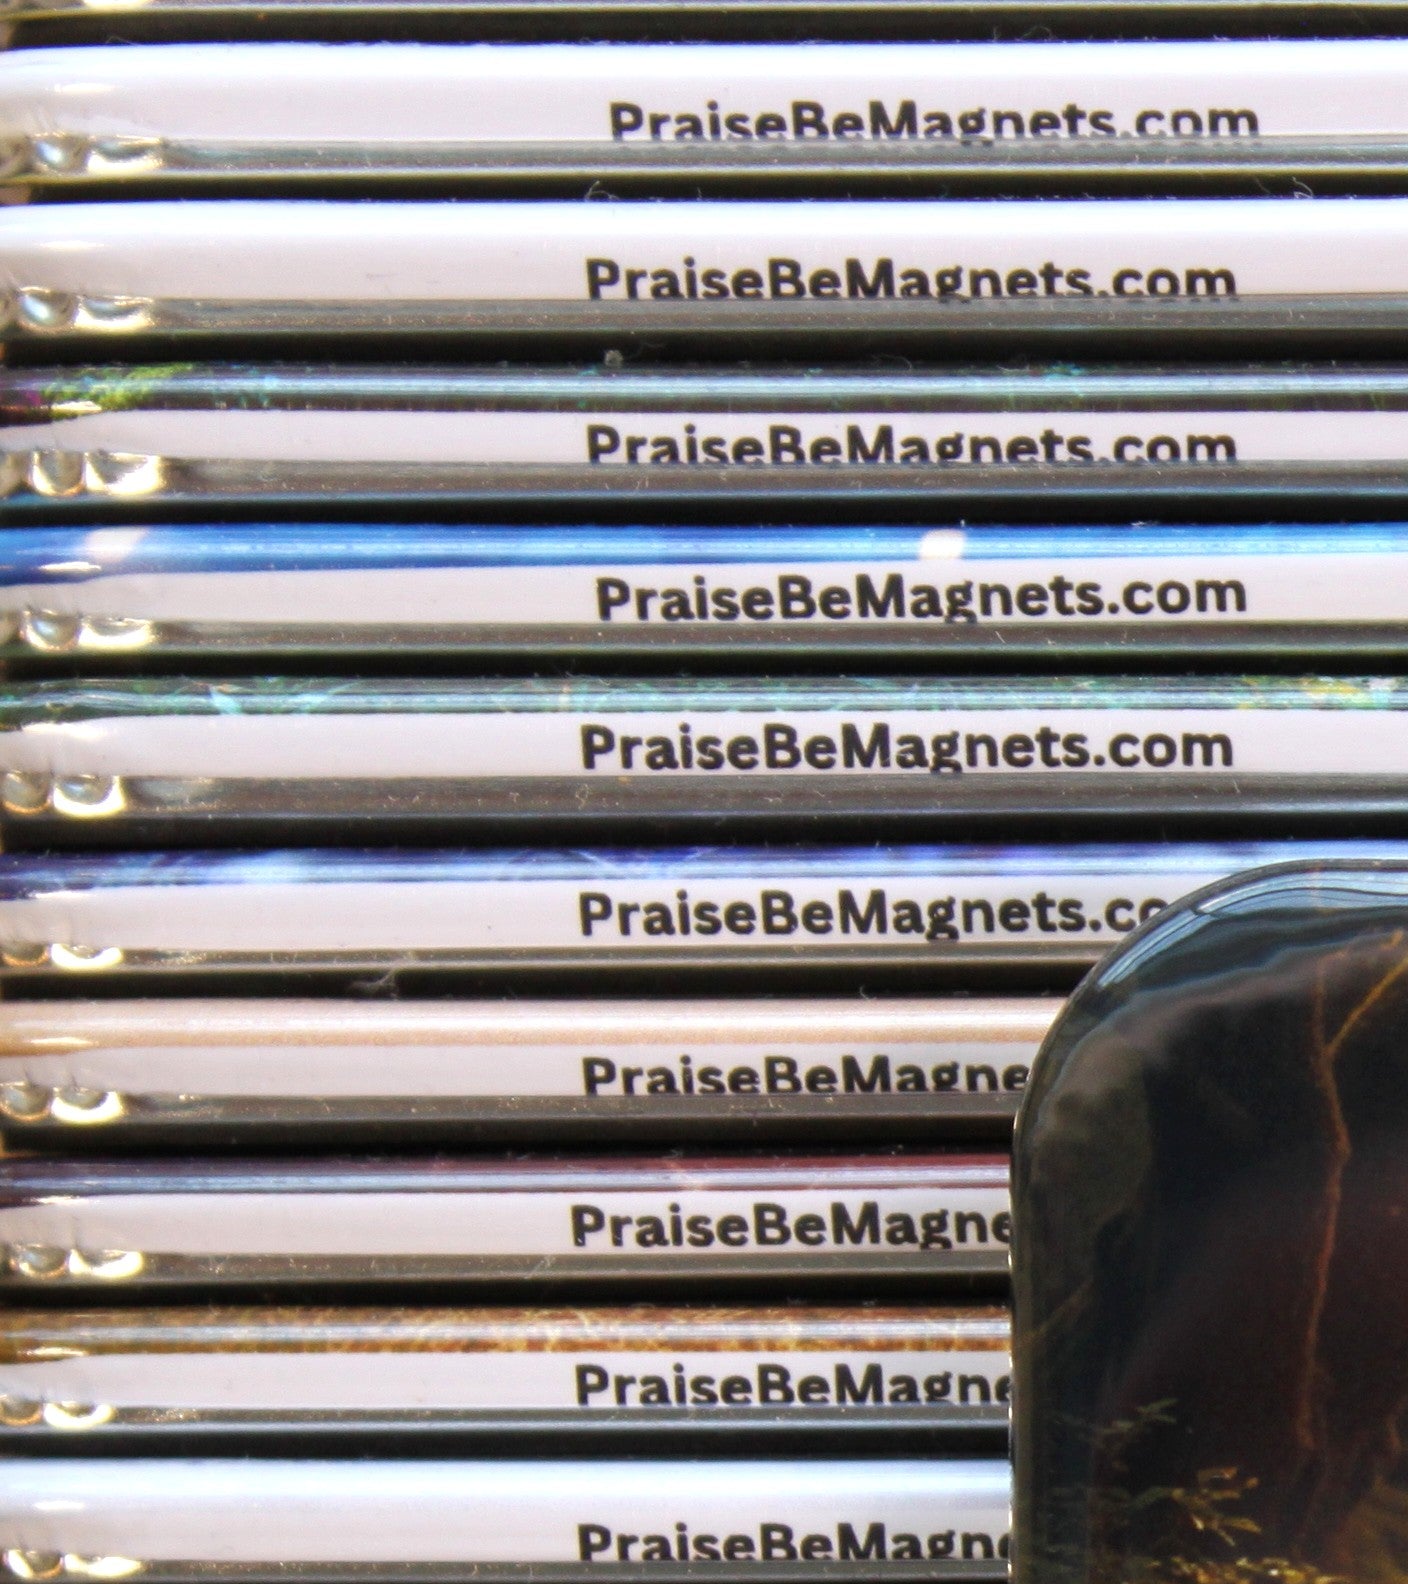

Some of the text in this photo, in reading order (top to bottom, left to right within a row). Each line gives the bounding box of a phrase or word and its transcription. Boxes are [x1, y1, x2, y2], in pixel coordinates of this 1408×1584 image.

[586, 257, 1237, 302] PraiseBeMagnets.com
[595, 573, 1247, 625] PraiseBeMagnets.com
[580, 721, 1233, 775] PraiseBeMagnets.com
[578, 889, 1166, 941] PraiseBeMagnets.co
[582, 1055, 1028, 1095] PraiseBeMagne
[570, 1202, 1011, 1250] PraiseBeMagne
